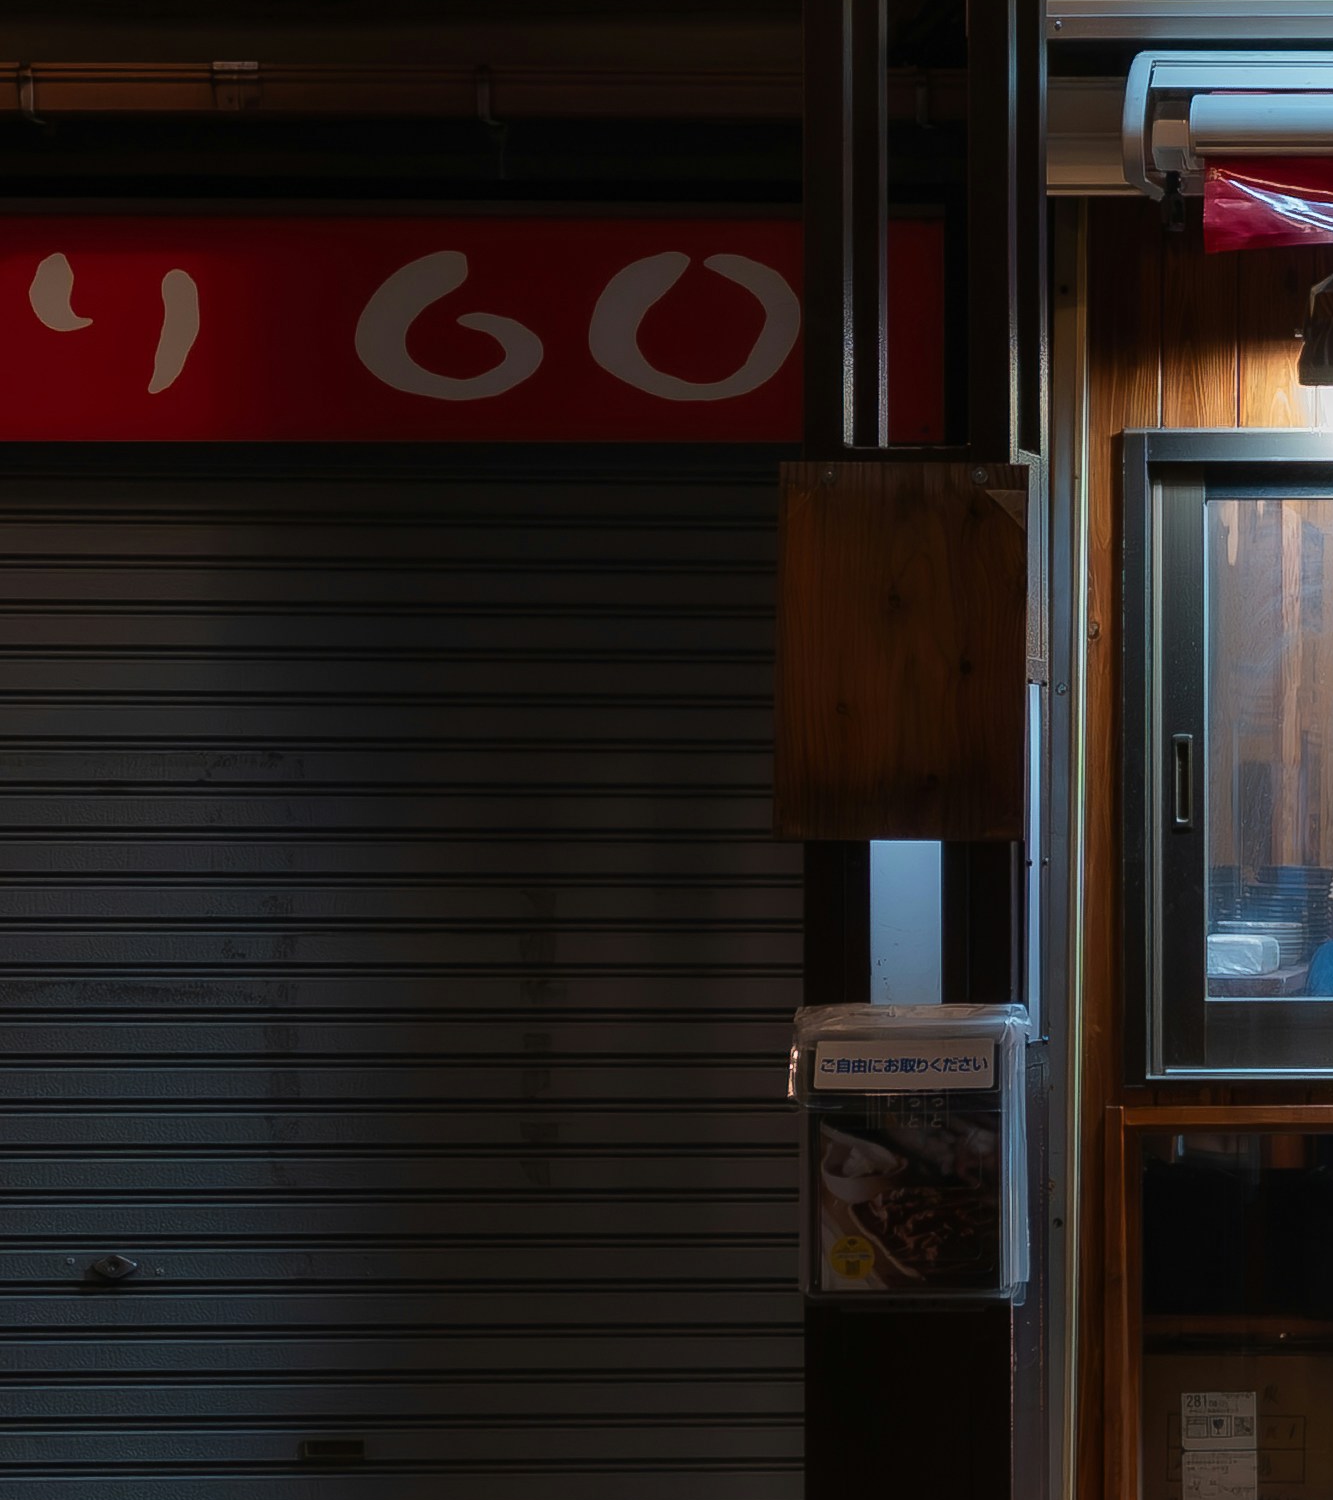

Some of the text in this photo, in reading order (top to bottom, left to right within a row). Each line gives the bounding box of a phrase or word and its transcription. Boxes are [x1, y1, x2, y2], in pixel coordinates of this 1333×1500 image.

[820, 1056, 988, 1074] ご自由にお取りください
